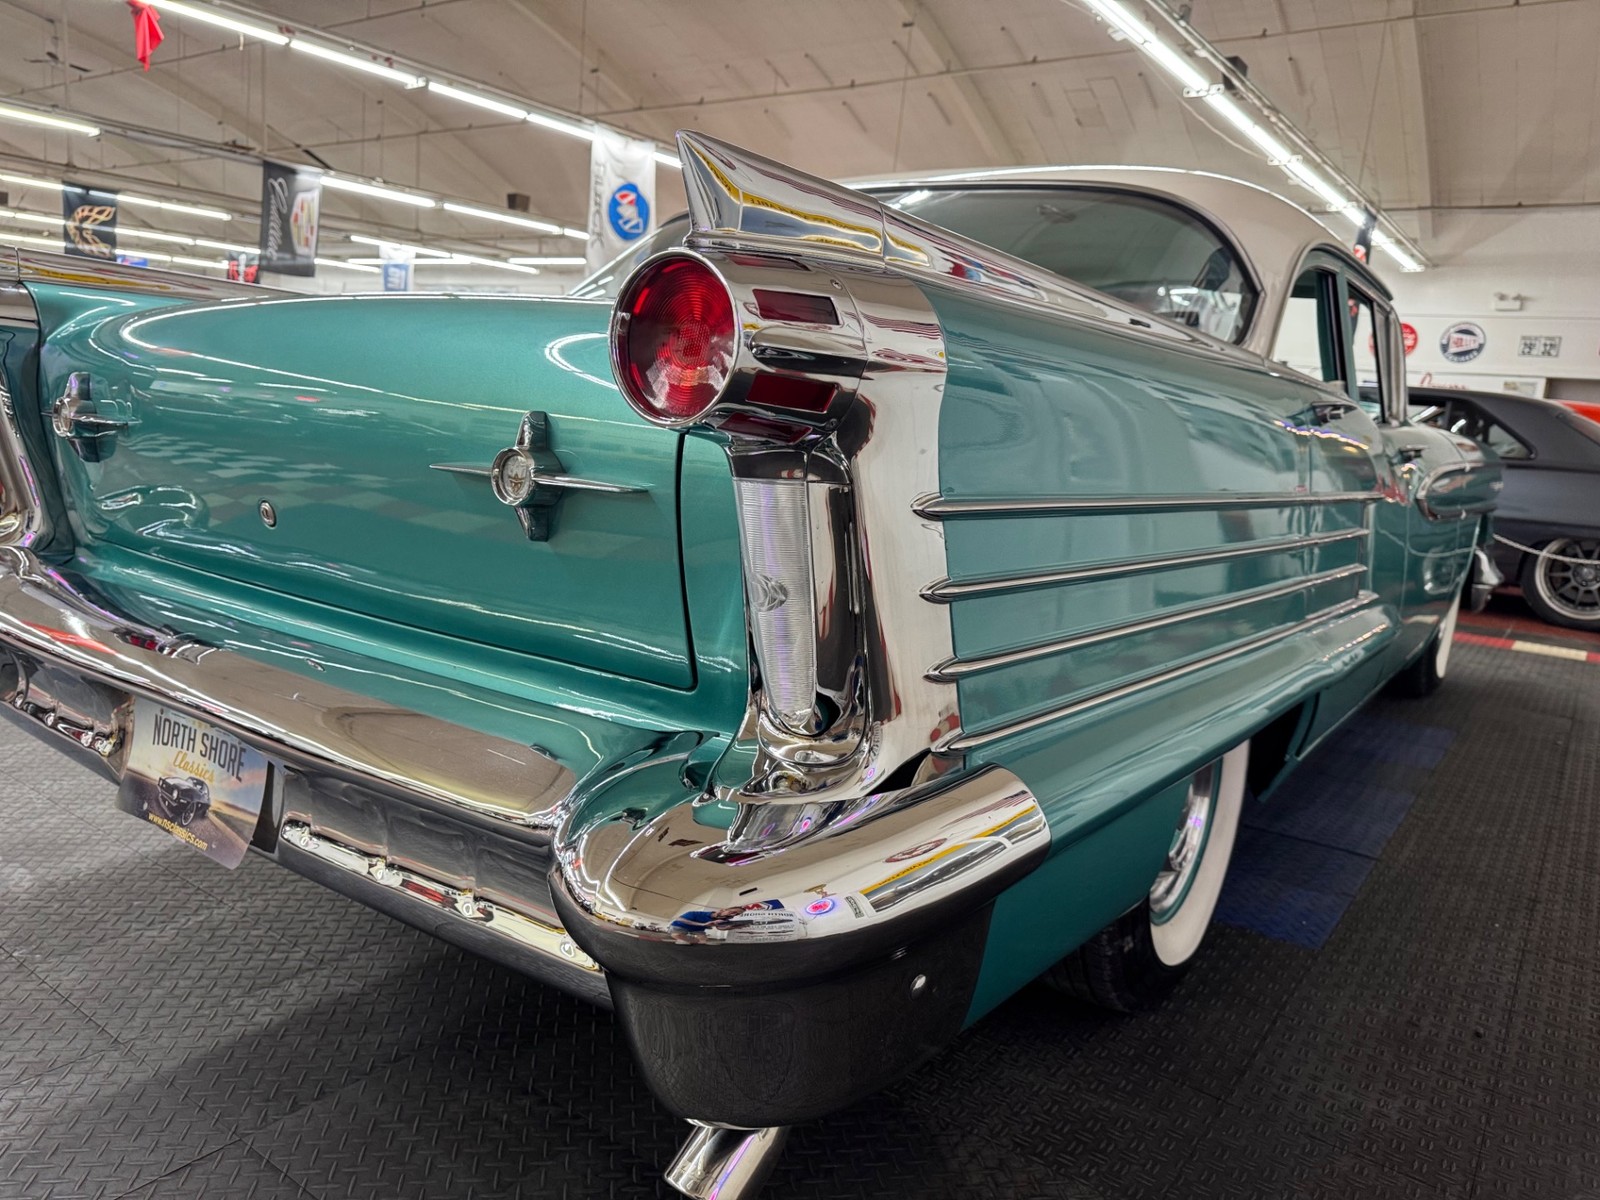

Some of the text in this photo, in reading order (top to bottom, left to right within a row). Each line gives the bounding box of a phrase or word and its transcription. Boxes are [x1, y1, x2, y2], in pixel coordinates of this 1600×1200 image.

[152, 714, 246, 782] NORTH SHORE
[173, 750, 215, 783] Classics
